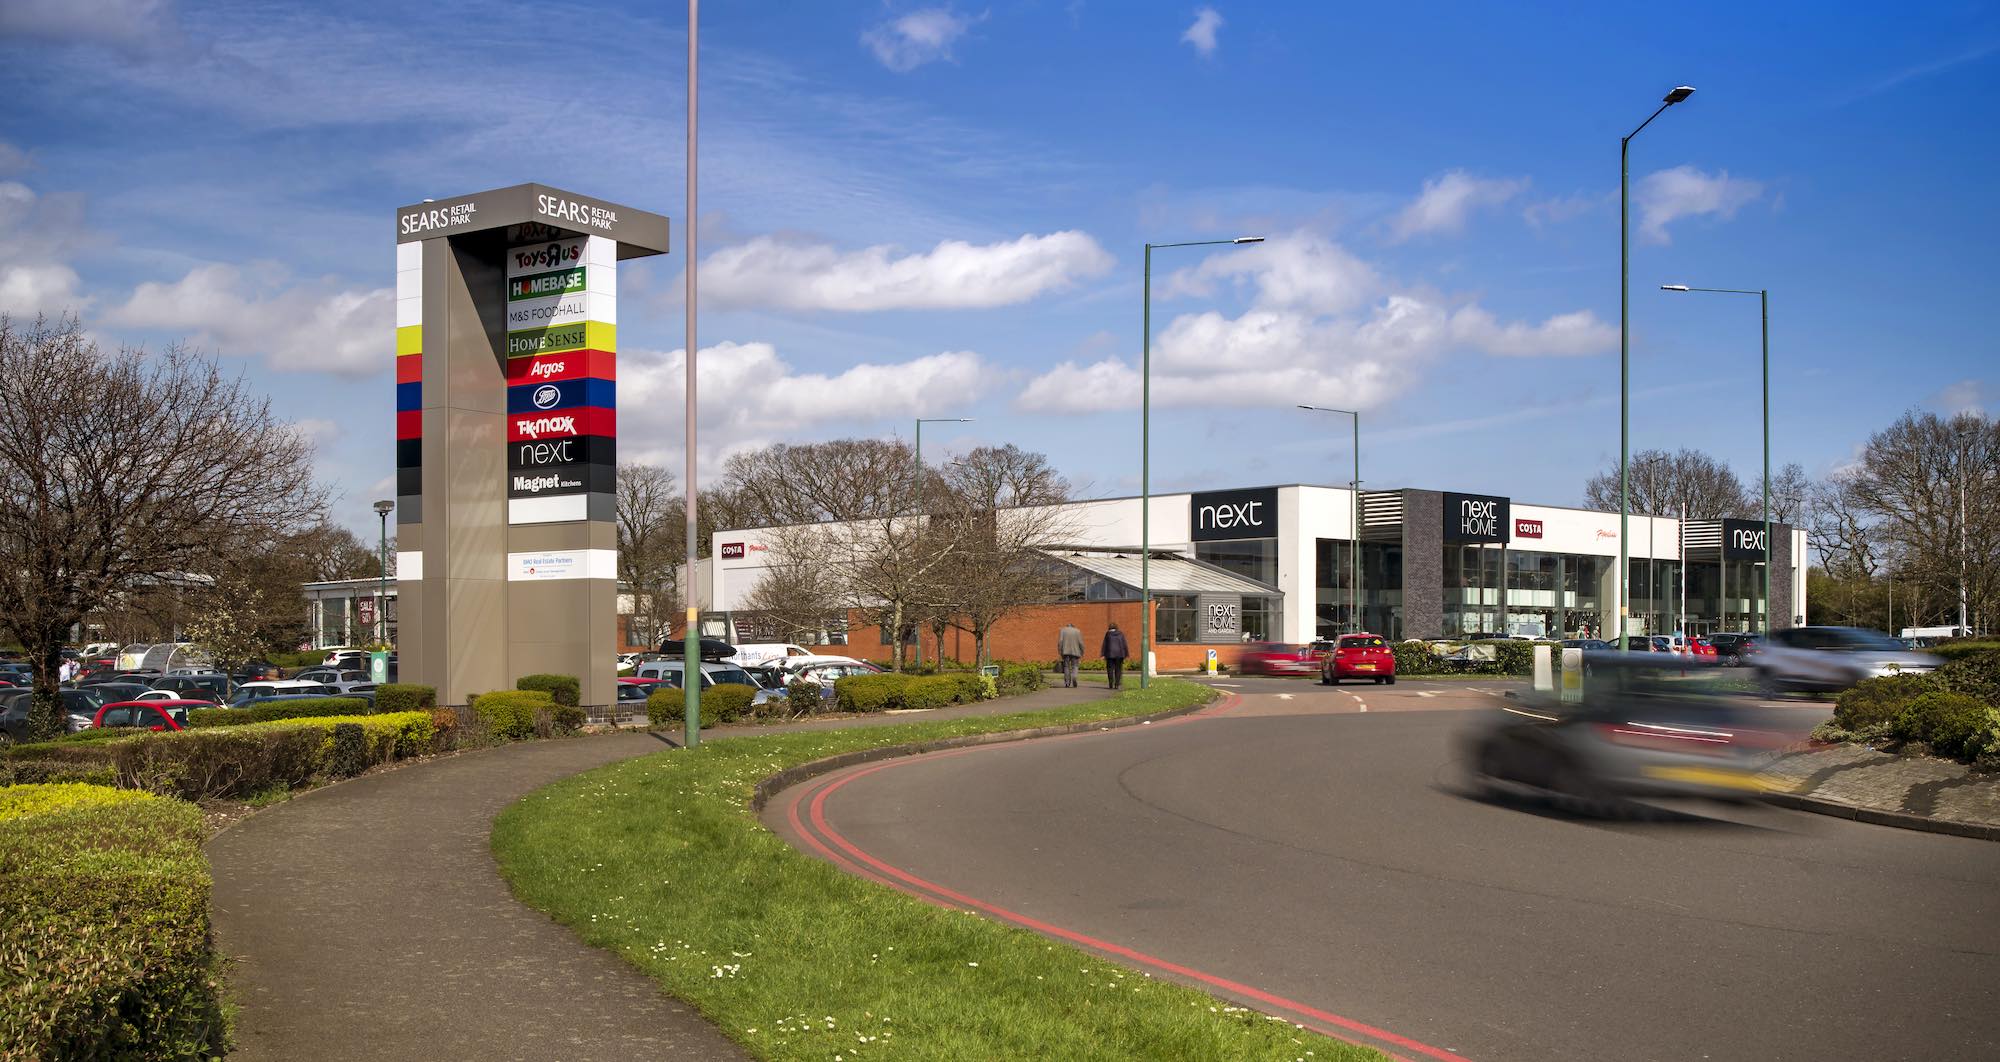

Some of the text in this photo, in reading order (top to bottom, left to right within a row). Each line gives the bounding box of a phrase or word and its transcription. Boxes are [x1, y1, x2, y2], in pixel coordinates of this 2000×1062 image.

[450, 202, 477, 216] RETAIL
[538, 194, 589, 224] SEARS
[591, 206, 618, 223] RETAIL
[401, 208, 449, 235] SEARS
[450, 214, 471, 226] PARK
[591, 216, 612, 231] PARK
[512, 272, 582, 297] HOMEBASE
[509, 303, 585, 324] M&S FOODHALL
[531, 361, 565, 379] Argos
[520, 440, 574, 465] next
[513, 473, 582, 493] Magnet Kitchens
[1199, 500, 1263, 530] next
[1461, 499, 1497, 520] next
[1461, 517, 1498, 536] HOME
[1519, 522, 1542, 534] COSTA
[1733, 528, 1766, 551] next
[722, 545, 742, 555] COSTA
[1208, 604, 1236, 617] next
[1208, 616, 1236, 629] HOME
